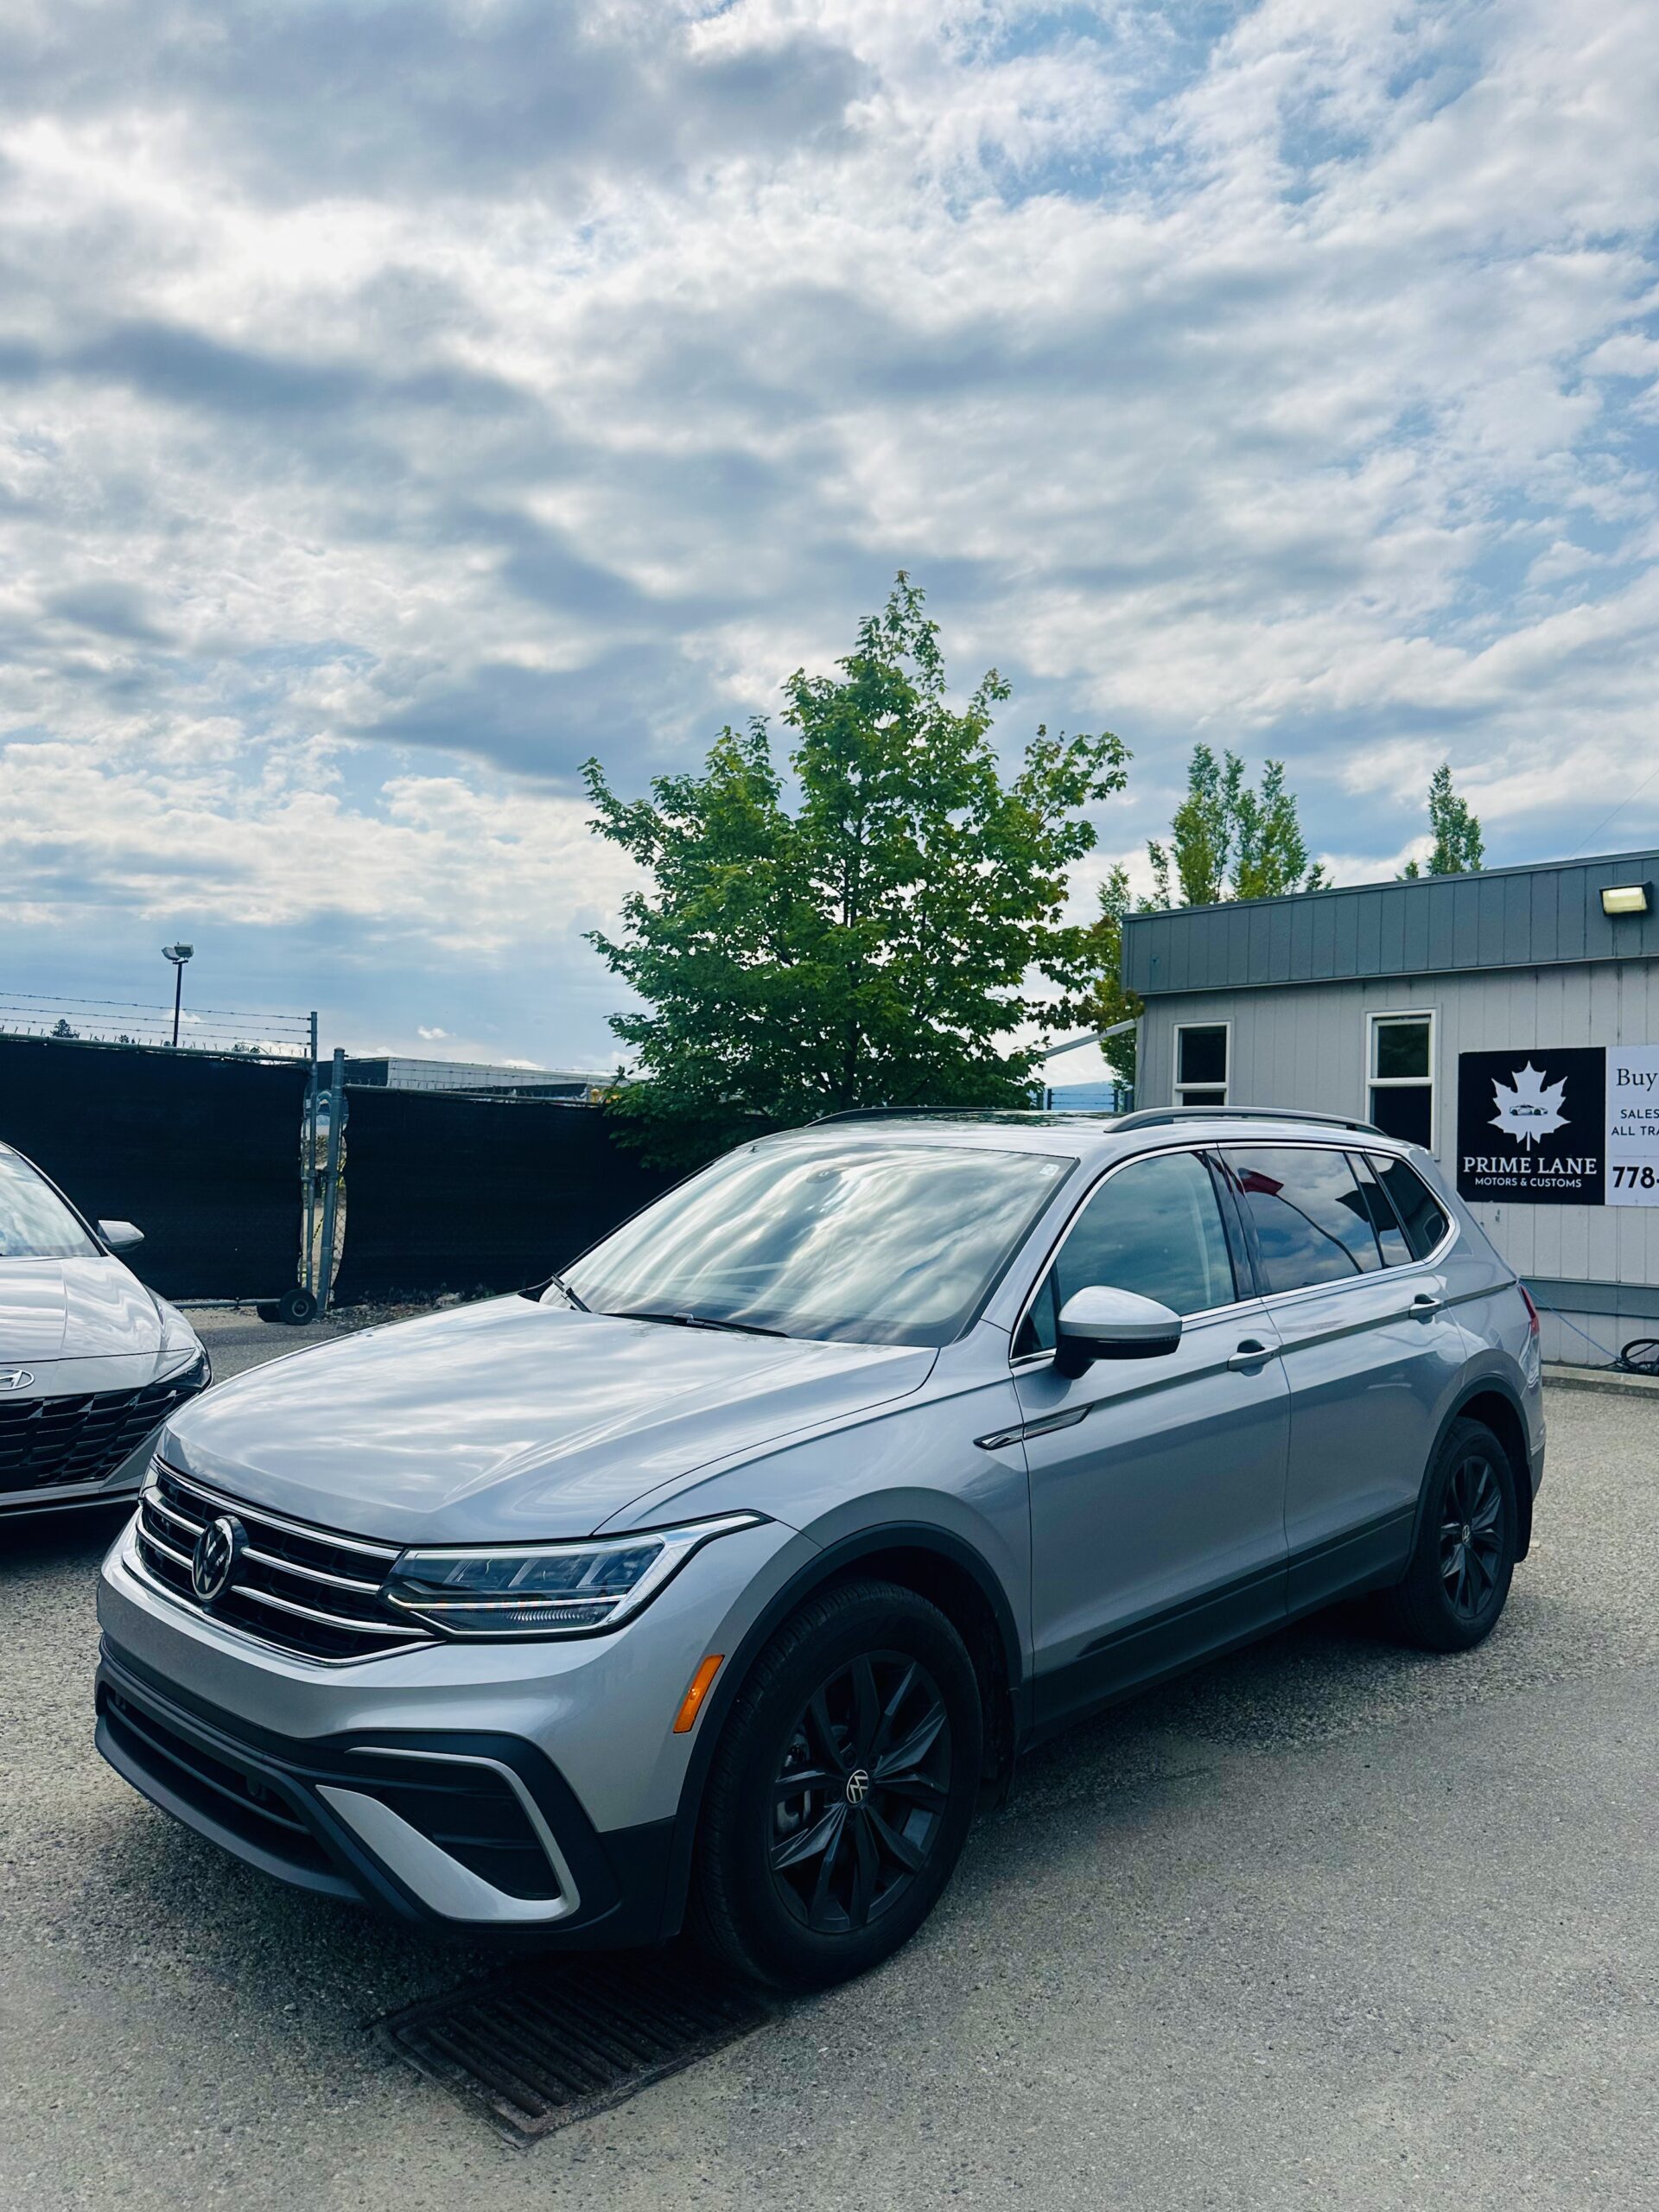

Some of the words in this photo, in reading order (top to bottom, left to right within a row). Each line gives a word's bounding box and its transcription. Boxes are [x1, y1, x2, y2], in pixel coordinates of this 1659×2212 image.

[1616, 1068, 1658, 1091] Buy
[1620, 1109, 1659, 1119] SALES
[1611, 1126, 1636, 1136] ALL
[1463, 1156, 1531, 1173] PRIME
[1537, 1158, 1598, 1174] LANE
[1475, 1177, 1517, 1186] MOTORS
[1520, 1178, 1528, 1187] &
[1529, 1178, 1582, 1188] CUSTOMS
